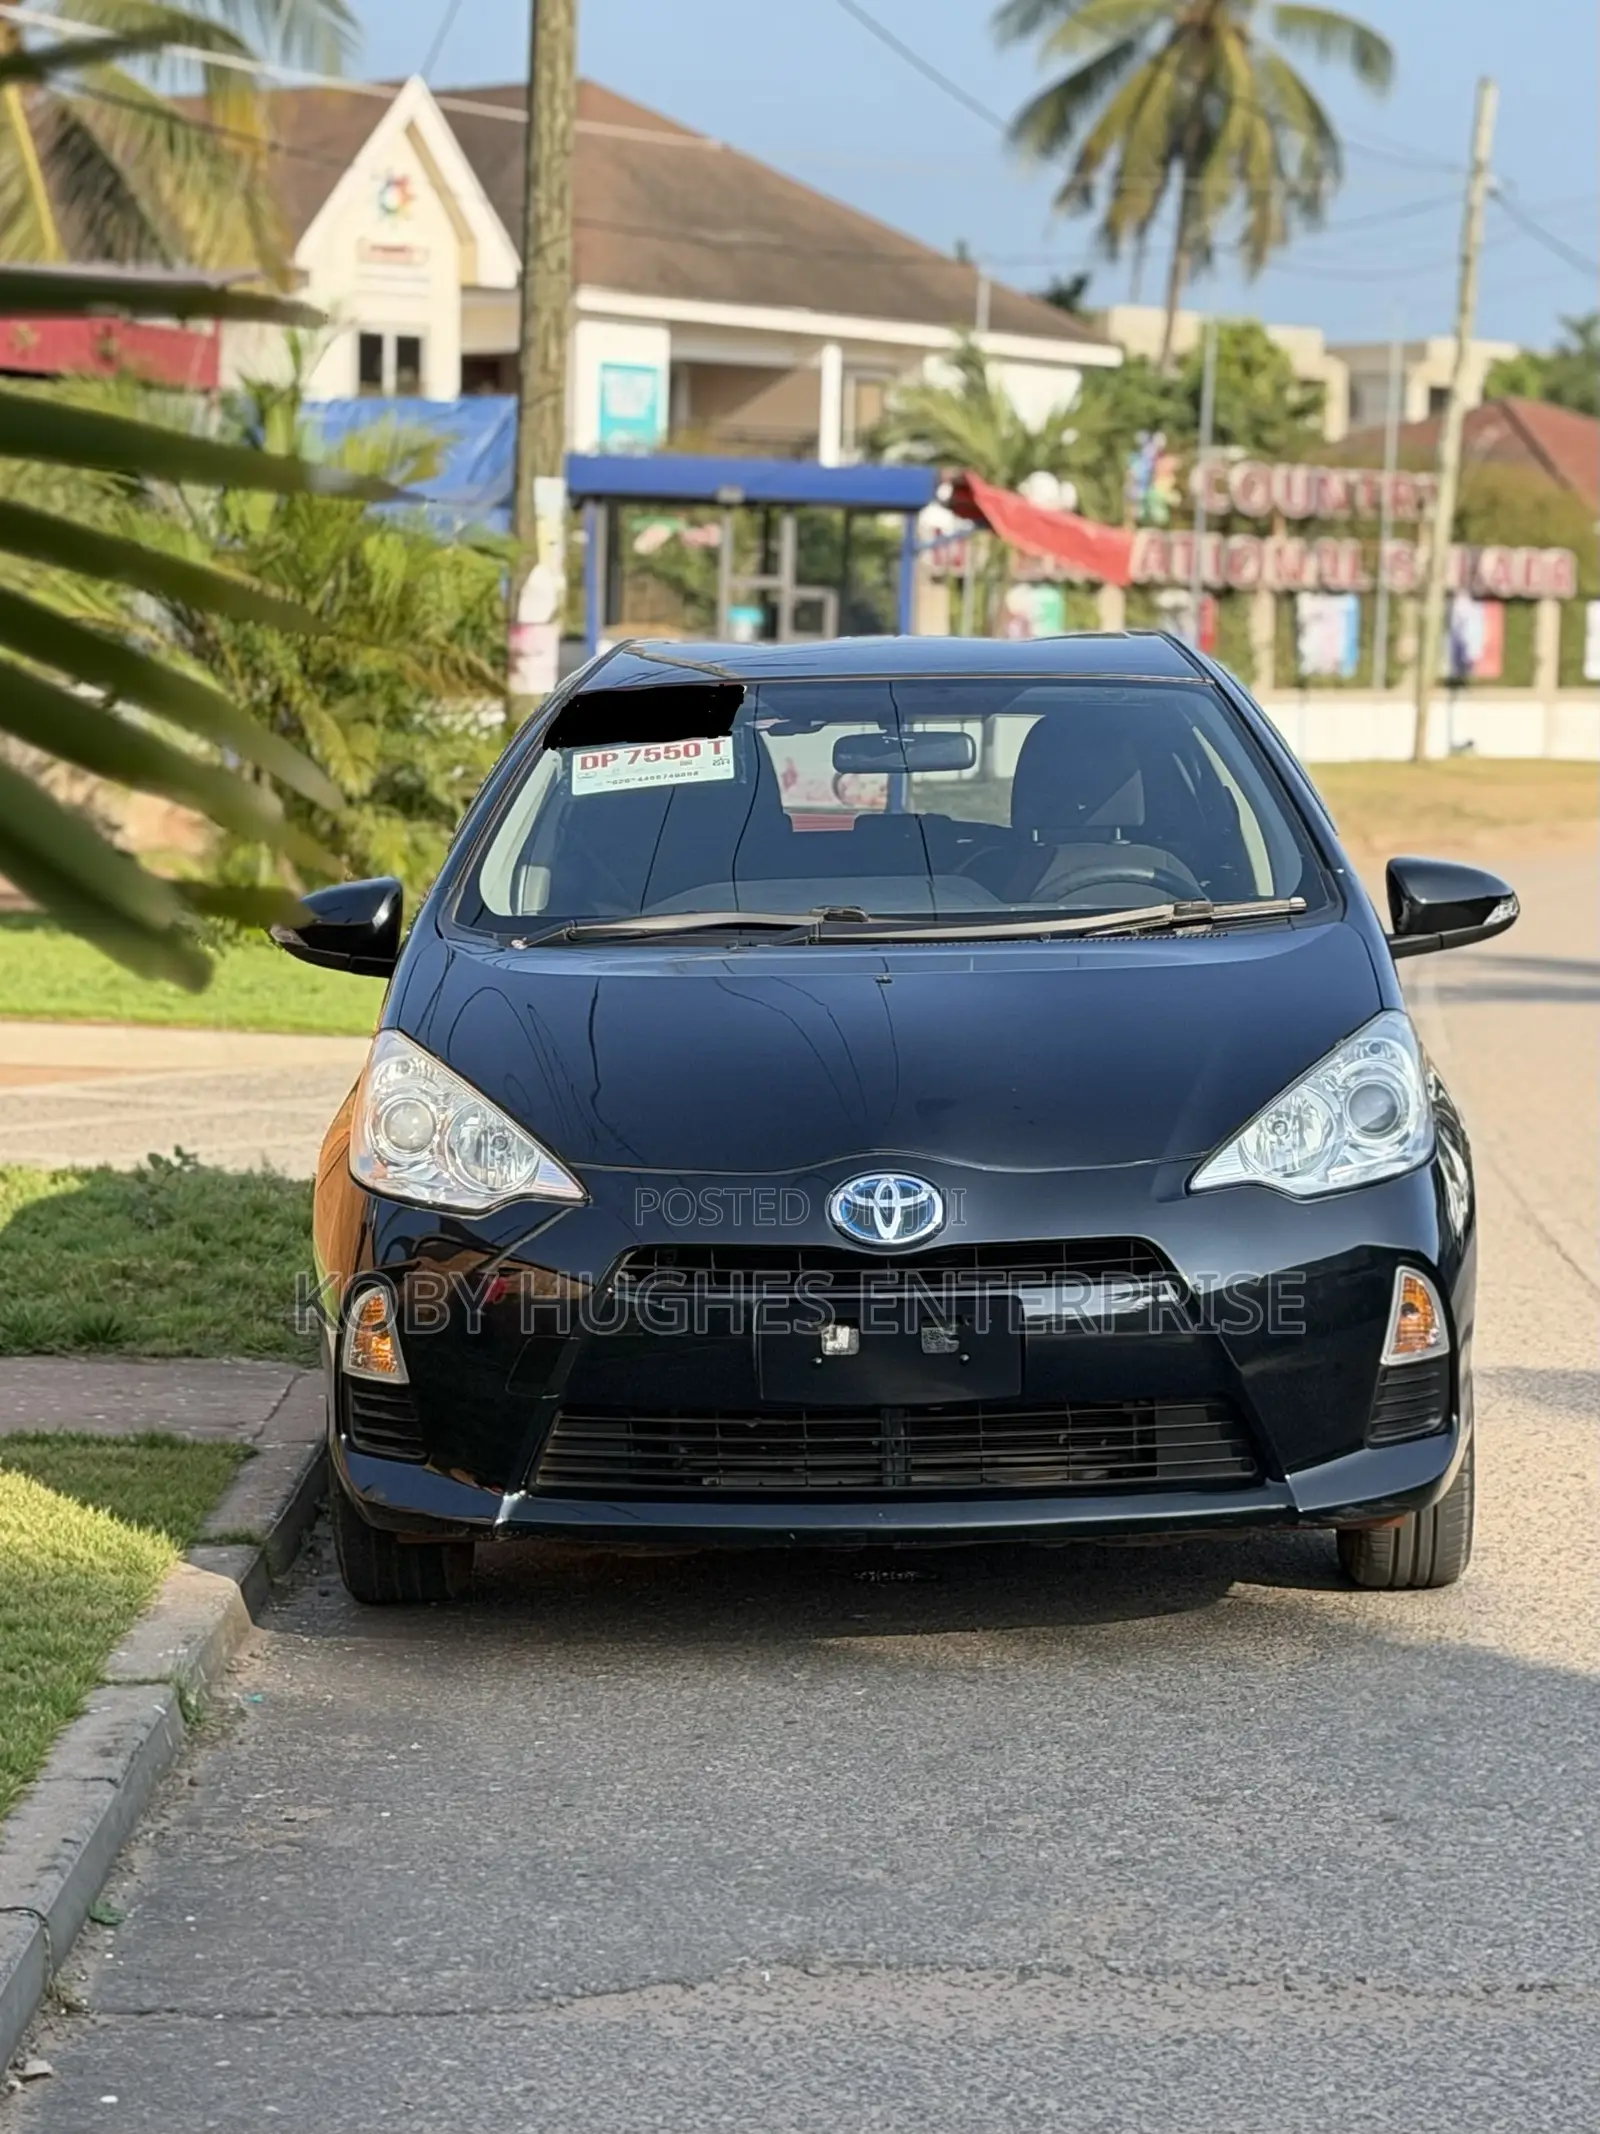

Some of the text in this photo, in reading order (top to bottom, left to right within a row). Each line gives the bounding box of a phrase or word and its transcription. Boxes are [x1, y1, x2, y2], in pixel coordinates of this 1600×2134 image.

[580, 752, 618, 770] DP
[624, 743, 702, 765] 7550
[707, 739, 726, 755] T
